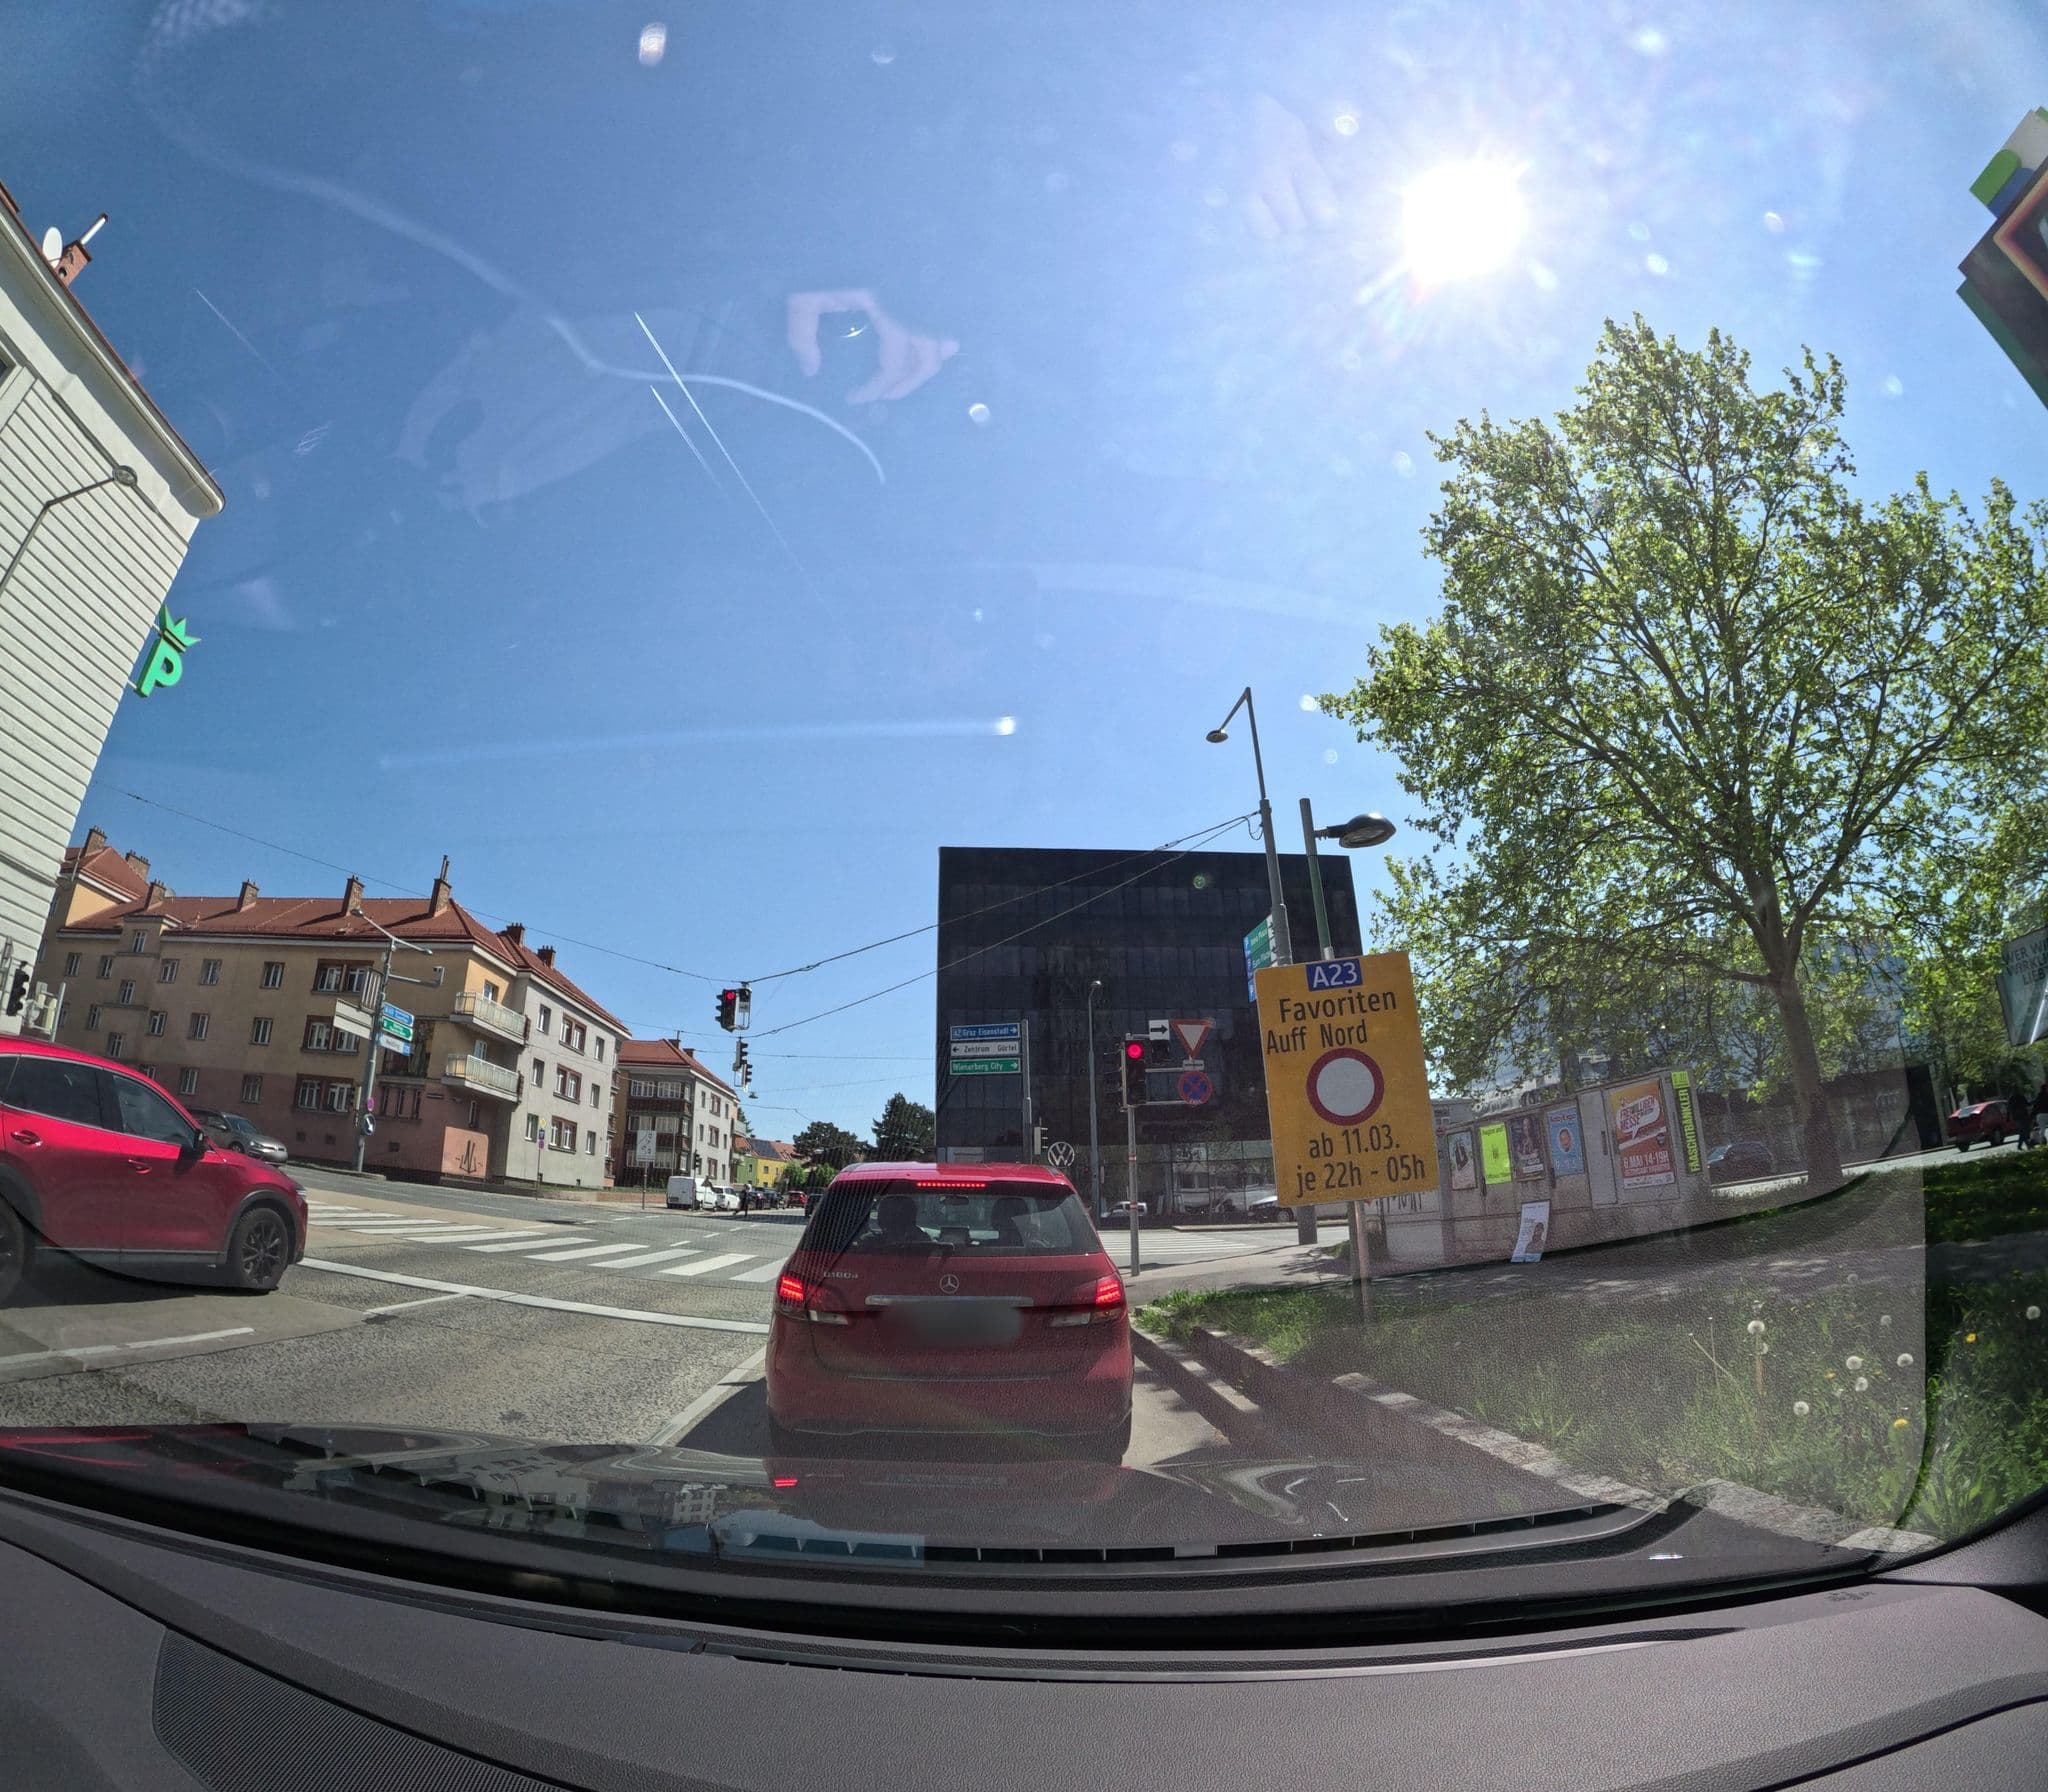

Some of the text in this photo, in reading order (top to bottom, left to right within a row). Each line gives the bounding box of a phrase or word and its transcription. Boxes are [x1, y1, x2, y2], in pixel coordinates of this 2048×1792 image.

[1313, 962, 1358, 989] A23
[1279, 989, 1397, 1023] Favoriten
[962, 1028, 977, 1037] Graz
[978, 1026, 1009, 1036] Eisenstadt
[1266, 1019, 1368, 1055] Auff Nord
[964, 1043, 1017, 1053] Zentrum Gürtel
[952, 1062, 1004, 1072] Wienerberg City
[1309, 1124, 1400, 1160] ab 11.03.
[1297, 1165, 1317, 1199] je
[1324, 1162, 1362, 1190] 22h
[1387, 1154, 1426, 1183] 05h
